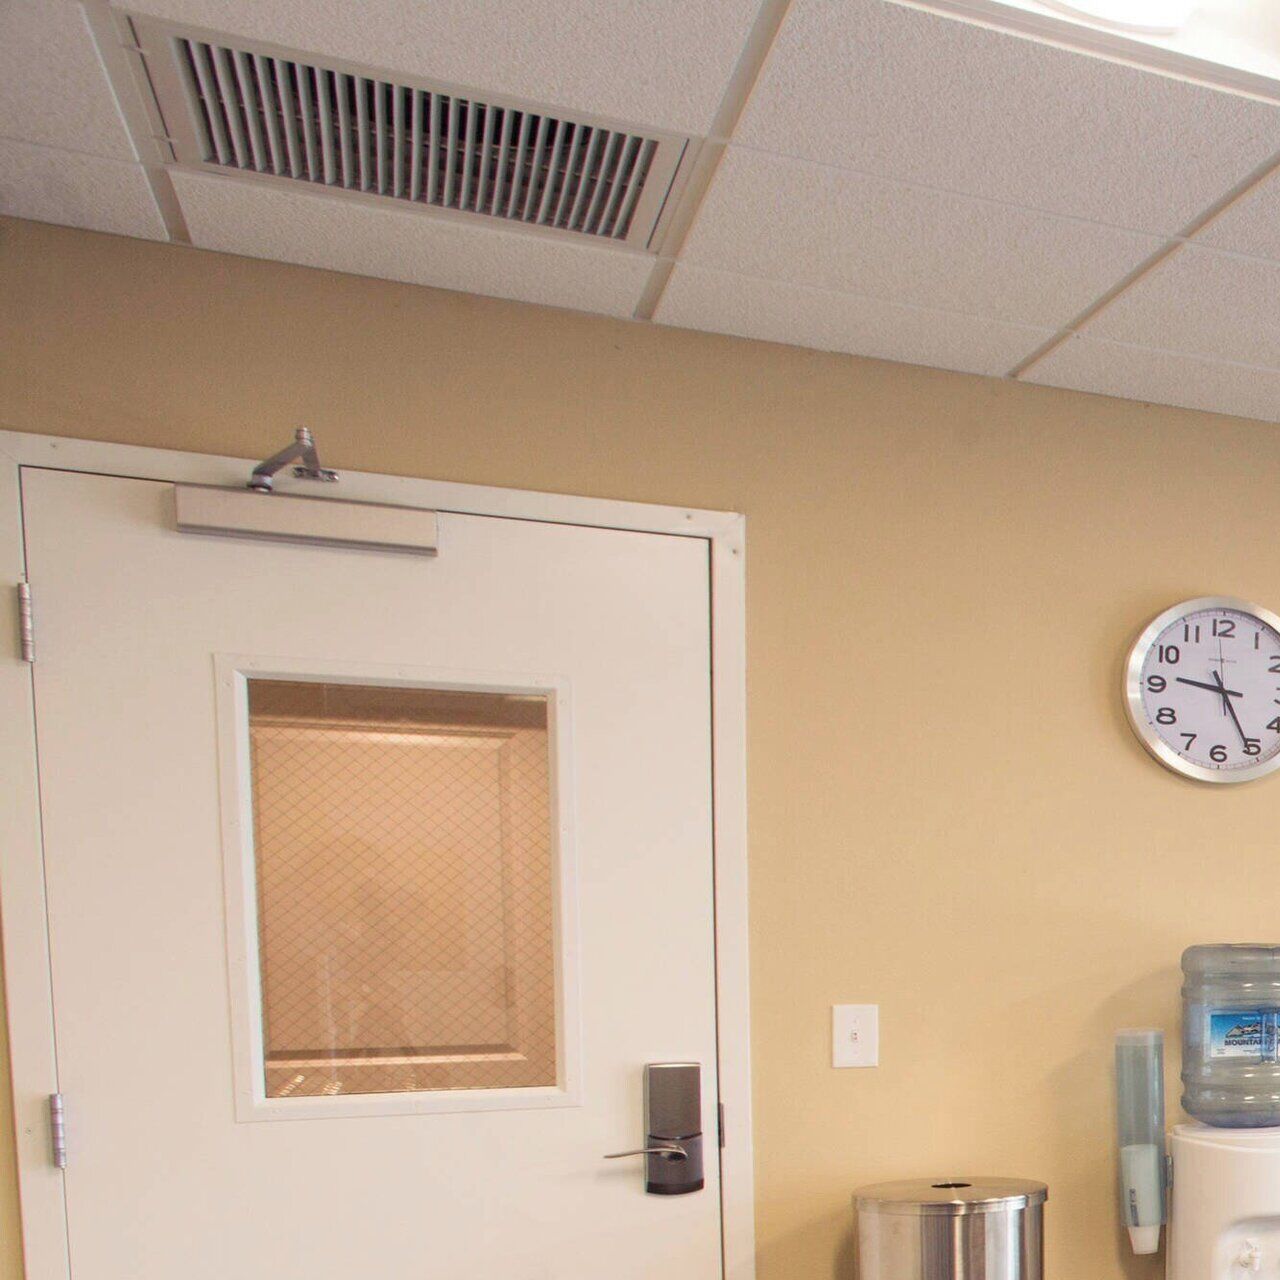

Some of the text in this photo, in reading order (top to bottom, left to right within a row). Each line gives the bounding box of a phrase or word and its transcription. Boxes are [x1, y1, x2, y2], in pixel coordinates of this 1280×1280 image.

[1184, 624, 1200, 643] 11
[1212, 619, 1236, 638] 12
[1254, 632, 1260, 650] 1
[1158, 644, 1180, 664] 10
[1147, 675, 1167, 693] 9
[1156, 707, 1177, 725] 8
[1180, 733, 1197, 751] 7
[1243, 738, 1262, 756] 5
[1209, 745, 1228, 763] 6
